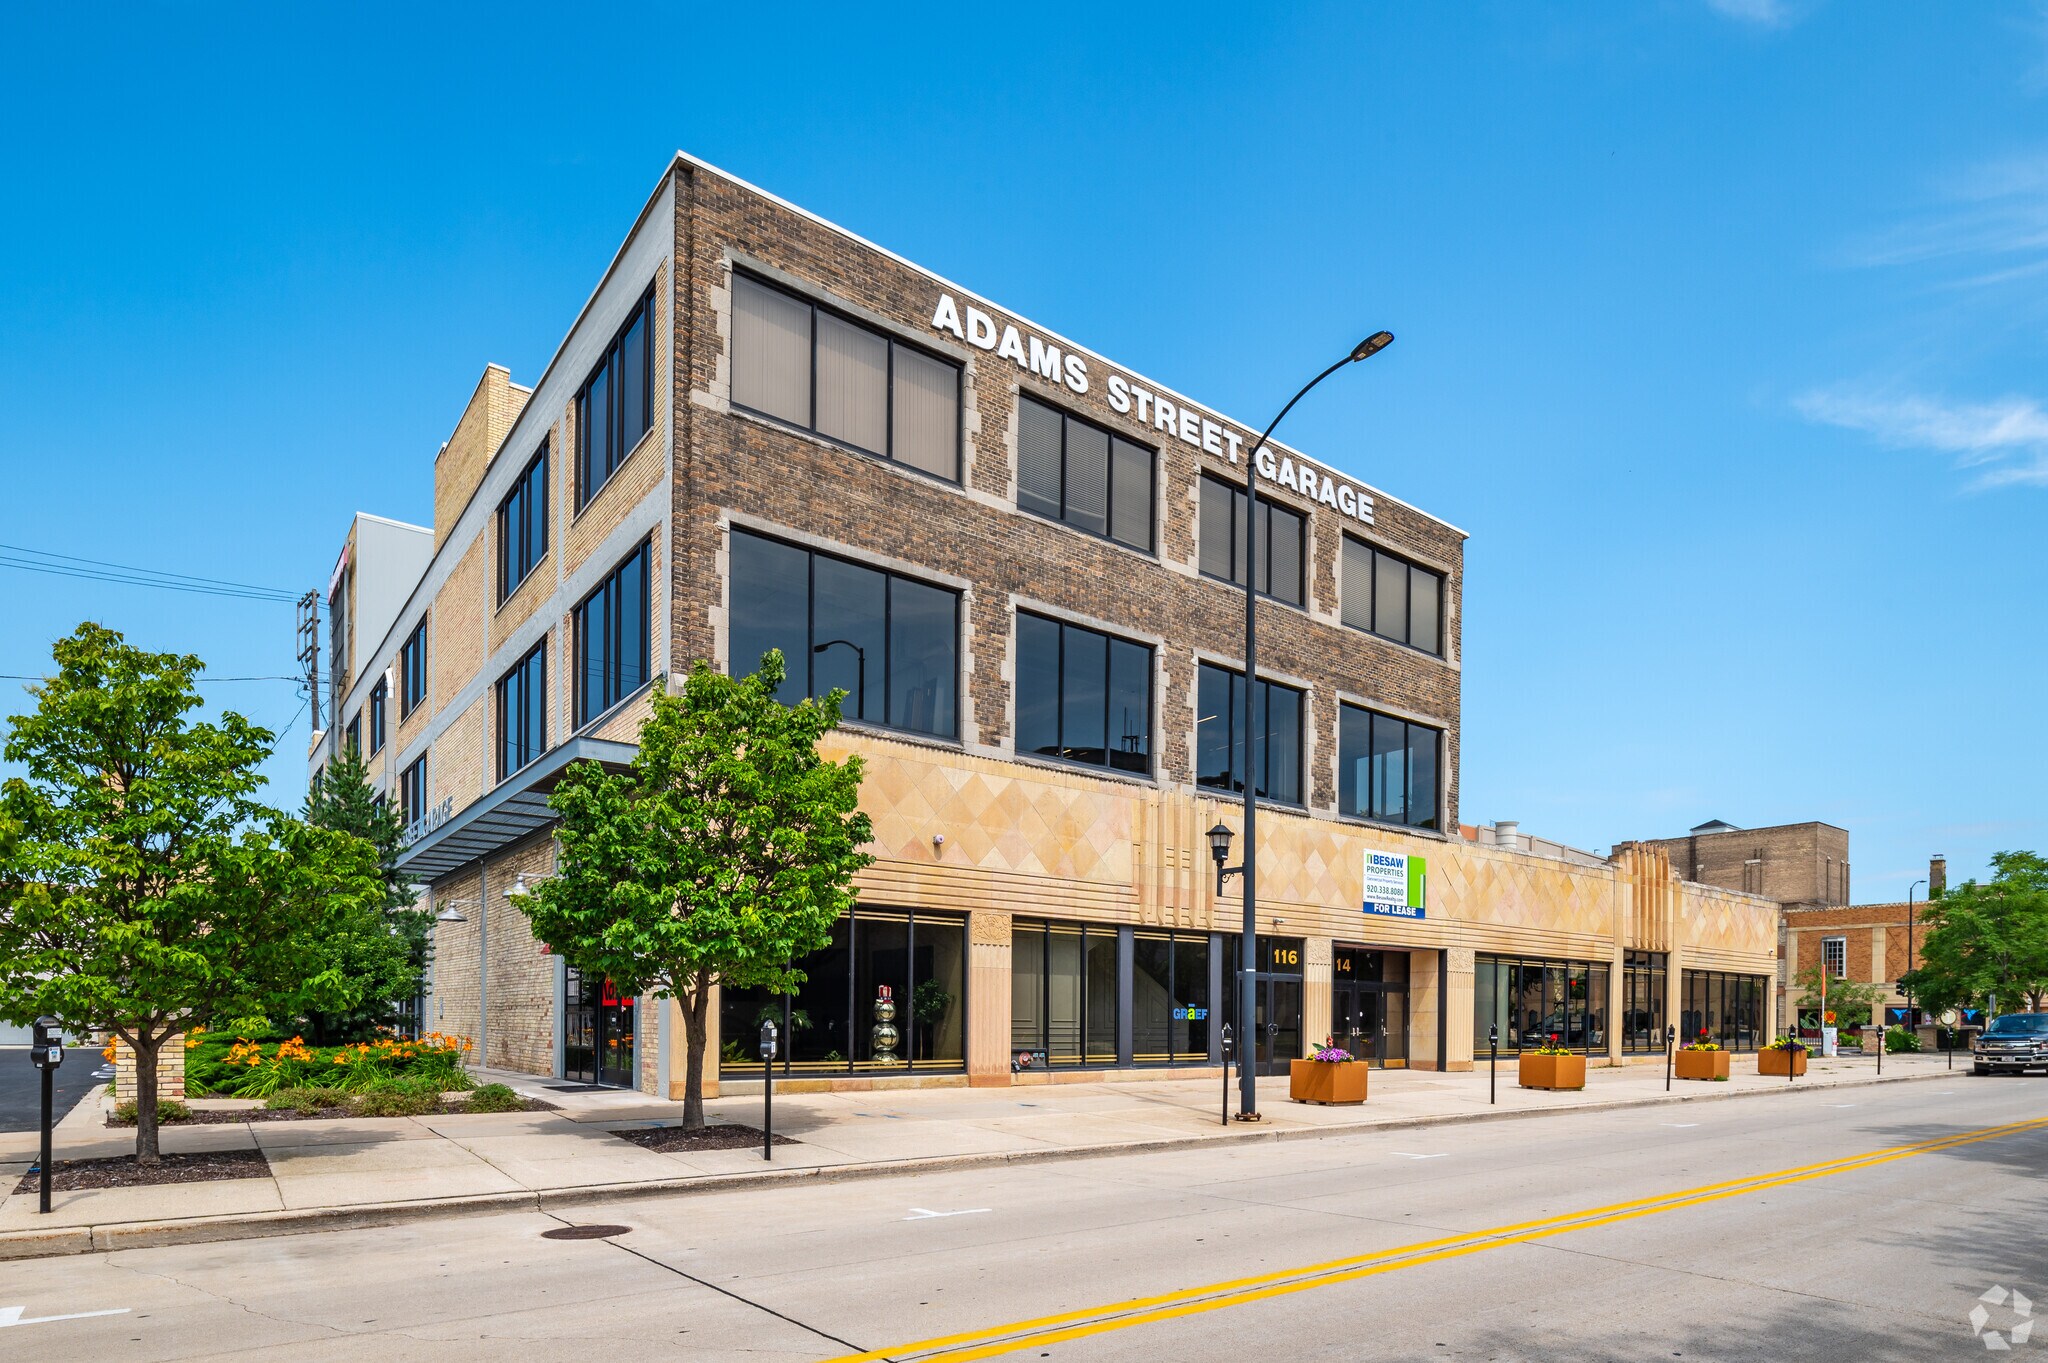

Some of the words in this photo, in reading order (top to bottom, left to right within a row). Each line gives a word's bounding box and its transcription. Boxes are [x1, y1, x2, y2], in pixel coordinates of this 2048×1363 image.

[931, 293, 1089, 395] ADAMS
[1107, 375, 1243, 464] STREET
[1255, 446, 1375, 526] GARAGE
[1373, 854, 1404, 868] BESAW
[1366, 865, 1404, 878] PROPERTIES
[1366, 884, 1404, 896] 920.338.8080
[1374, 903, 1390, 913] FOR
[1392, 905, 1417, 916] LEASE
[1274, 949, 1298, 965] 116
[1337, 958, 1351, 972] 14
